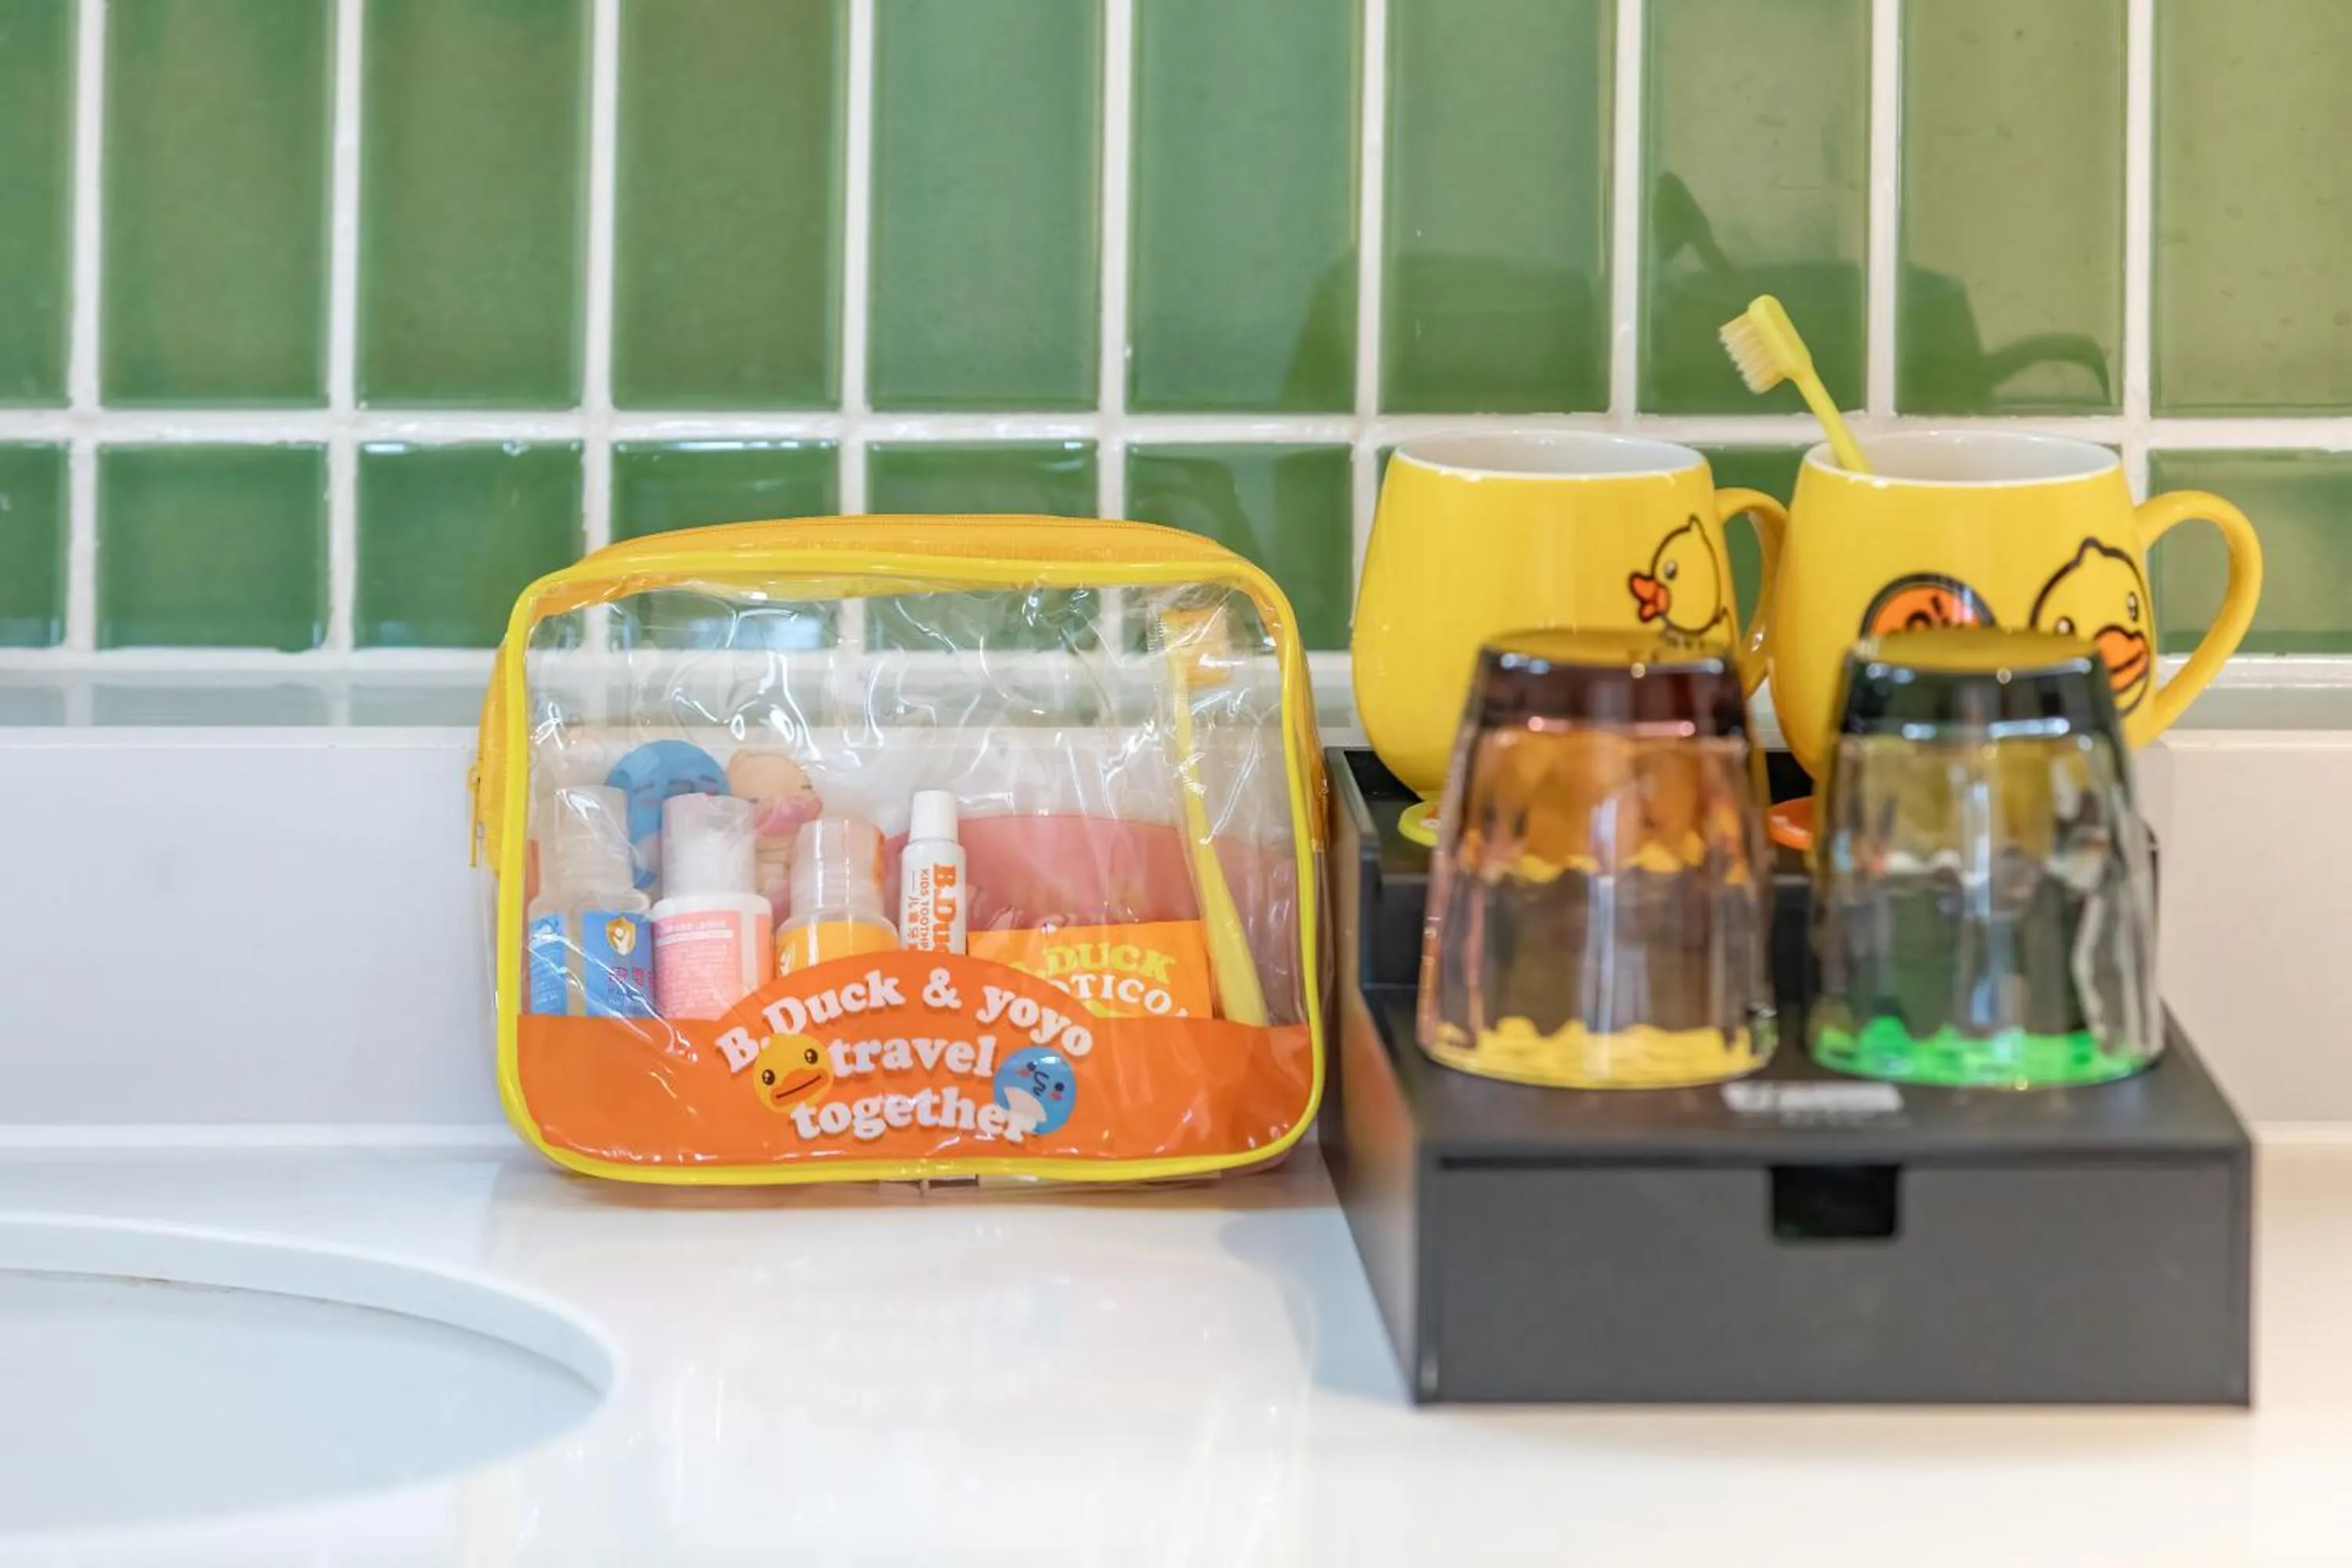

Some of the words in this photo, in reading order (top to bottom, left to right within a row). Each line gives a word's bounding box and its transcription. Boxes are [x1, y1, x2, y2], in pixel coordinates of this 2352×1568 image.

[920, 869, 929, 896] KIDS
[1049, 973, 1189, 1017] TICO
[715, 969, 906, 1073] B.Duck
[921, 967, 962, 1009] &
[976, 985, 1094, 1057] yoyo
[827, 1034, 998, 1078] travel
[789, 1085, 1038, 1143] together
